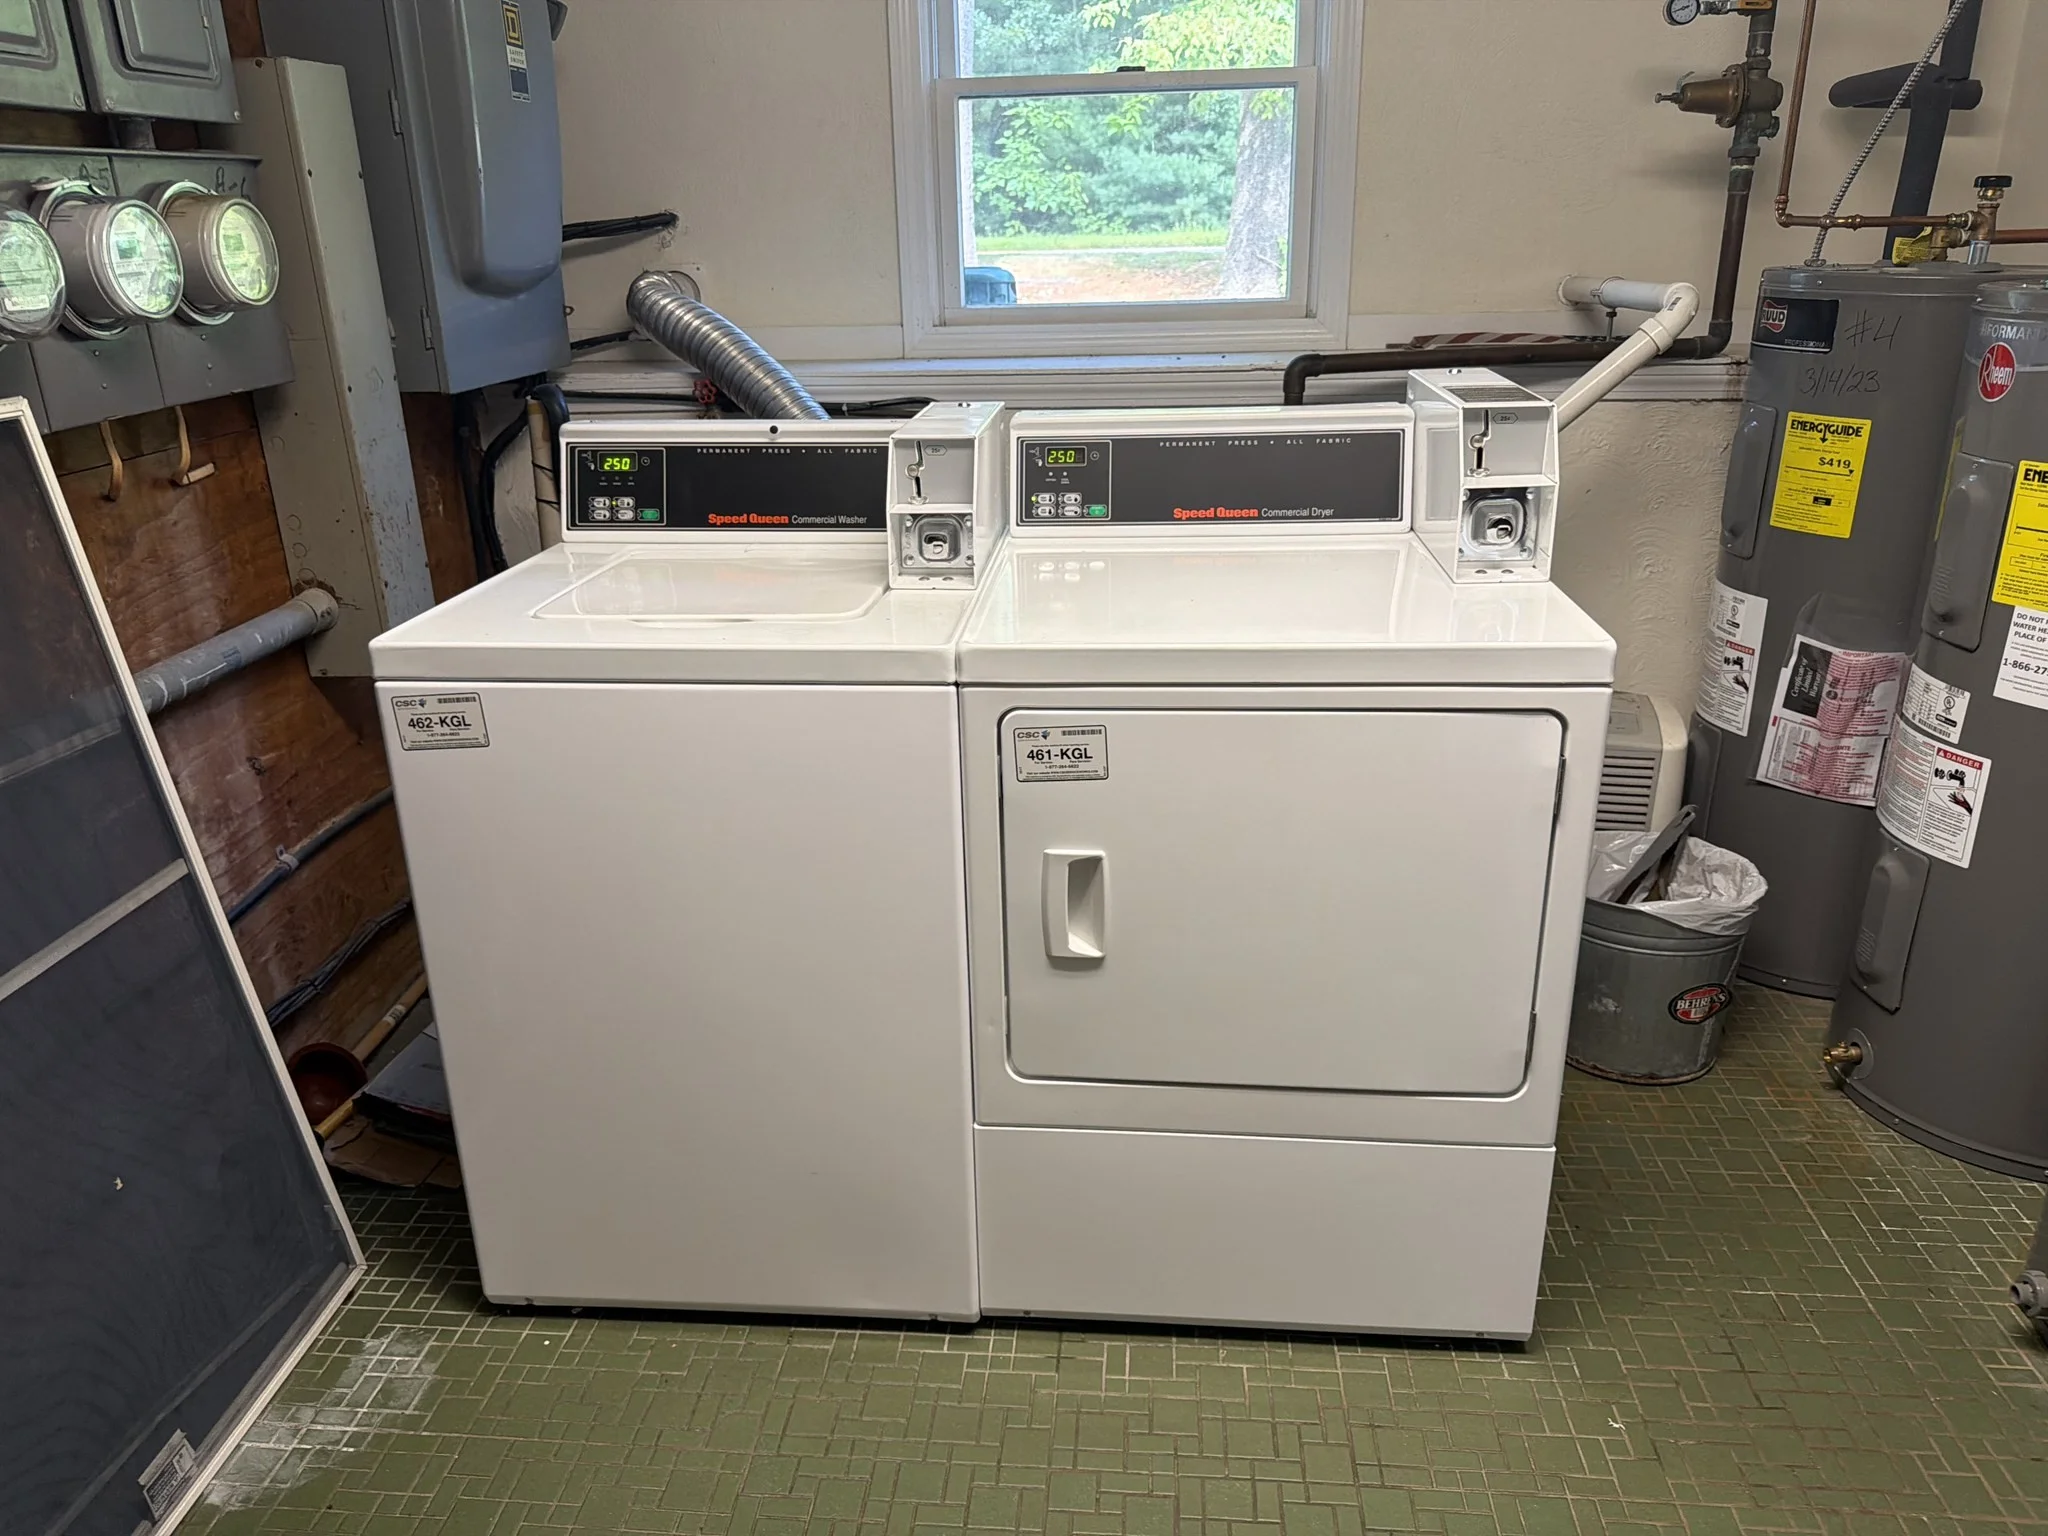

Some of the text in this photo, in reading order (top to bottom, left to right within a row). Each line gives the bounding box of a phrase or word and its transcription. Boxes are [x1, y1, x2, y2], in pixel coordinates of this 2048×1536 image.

[1762, 309, 1786, 323] RUUD
[1844, 309, 1901, 350] #4
[1980, 345, 2013, 391] Rheem
[1801, 363, 1880, 398] 3/14/23
[1790, 419, 1863, 438] ENERGYGUIDE
[1048, 450, 1075, 463] 250
[603, 457, 631, 470] 250
[708, 513, 867, 525] Speed Queen Commercial Washer
[1173, 506, 1334, 520] Speed Queen Commercial Dryer
[2017, 612, 2027, 621] DO
[2029, 615, 2045, 624] NOT
[2013, 621, 2036, 632] WATER
[2014, 631, 2047, 643] PLACE OF
[2003, 658, 2048, 677] 1-866-27
[395, 700, 417, 708] CSC
[408, 715, 472, 729] 462-KGL
[1017, 731, 1040, 739] CSC
[1027, 747, 1093, 760] 461-KGL
[1946, 752, 1980, 769] DANGER
